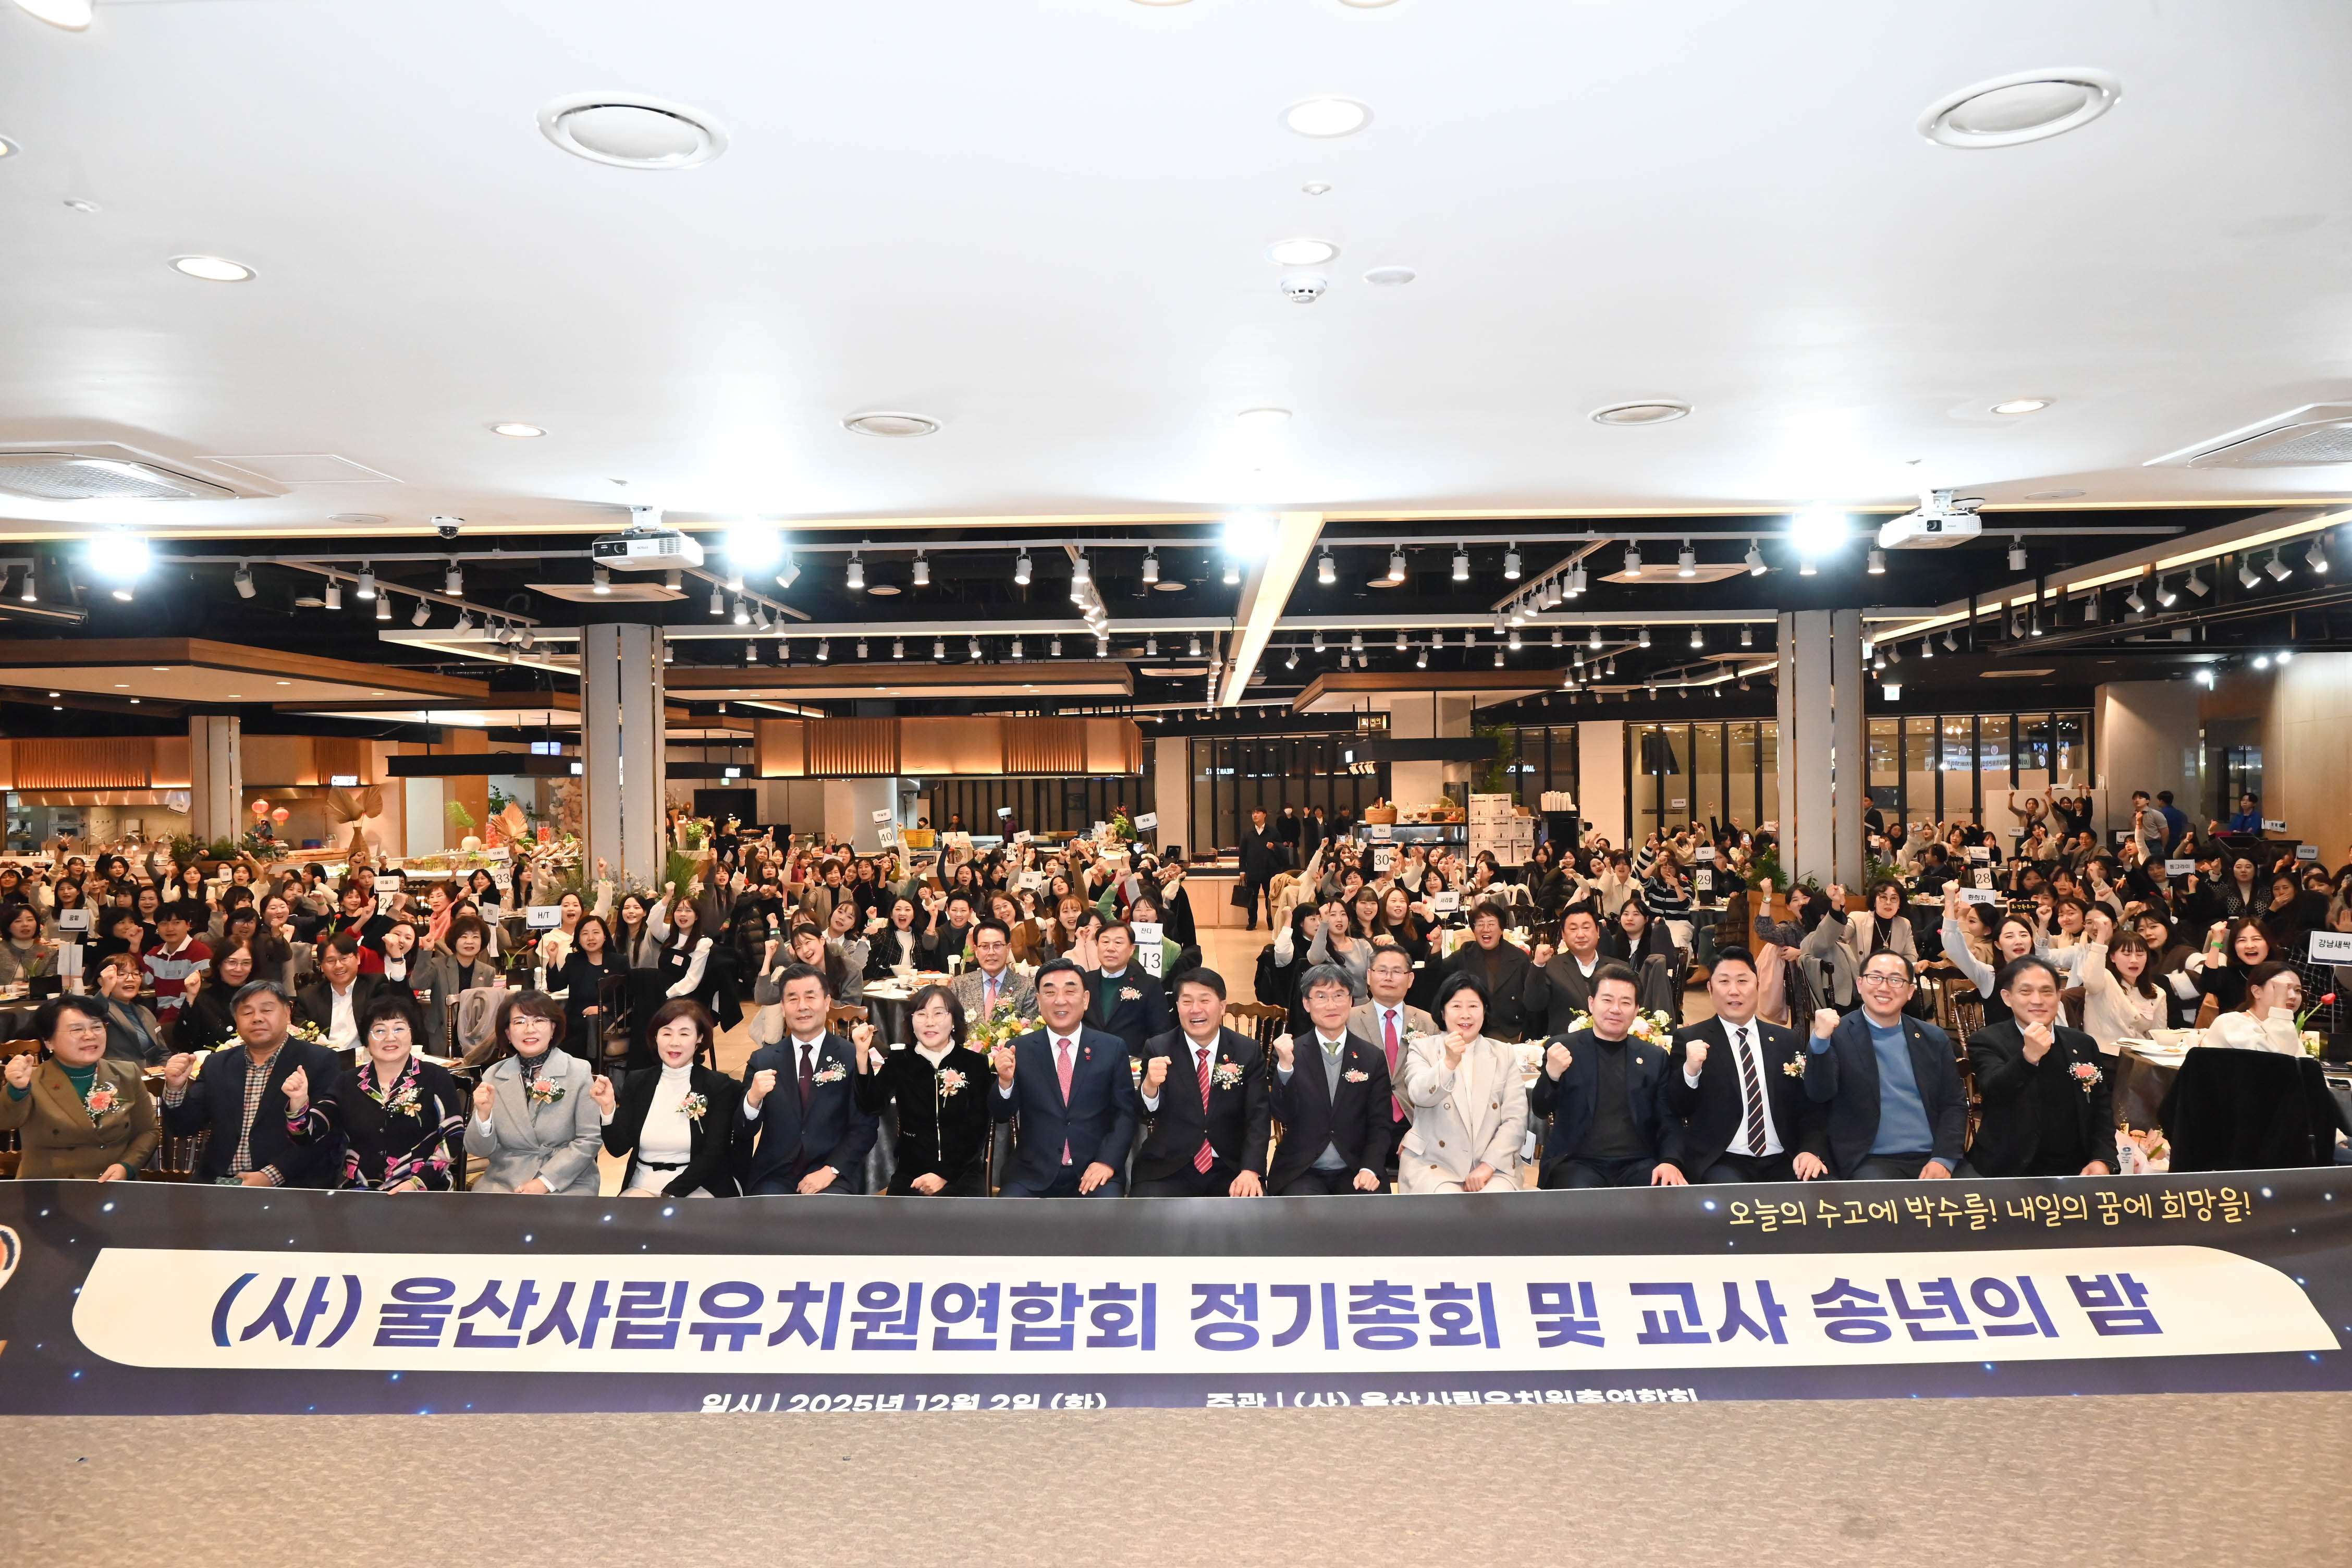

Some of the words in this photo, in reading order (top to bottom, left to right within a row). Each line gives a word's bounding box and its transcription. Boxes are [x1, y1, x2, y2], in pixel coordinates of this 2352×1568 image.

[881, 832, 892, 842] 40
[1375, 854, 1389, 865] 30
[496, 873, 510, 884] 33
[1697, 875, 1711, 885] 29
[1976, 873, 1990, 884] 28
[2319, 939, 2350, 949] 강남새싹
[1143, 953, 1161, 969] 13
[1730, 1200, 1807, 1232] 오늘의
[1817, 1199, 1898, 1228] 수고에
[1905, 1193, 1998, 1230] 박수를!
[2006, 1193, 2088, 1227] 내일의
[2096, 1191, 2152, 1226] 꿈에
[2160, 1187, 2252, 1223] 희망을!
[1191, 1280, 1501, 1351] 정기총회
[1527, 1282, 1605, 1348] 및
[1630, 1280, 1788, 1345] 교사
[1811, 1276, 2060, 1343] 송년의
[2065, 1273, 2163, 1336] 밤
[787, 1394, 904, 1412] 2025년
[916, 1394, 980, 1411] 12월
[989, 1394, 1040, 1410] 2일
[1051, 1393, 1107, 1410] (화)
